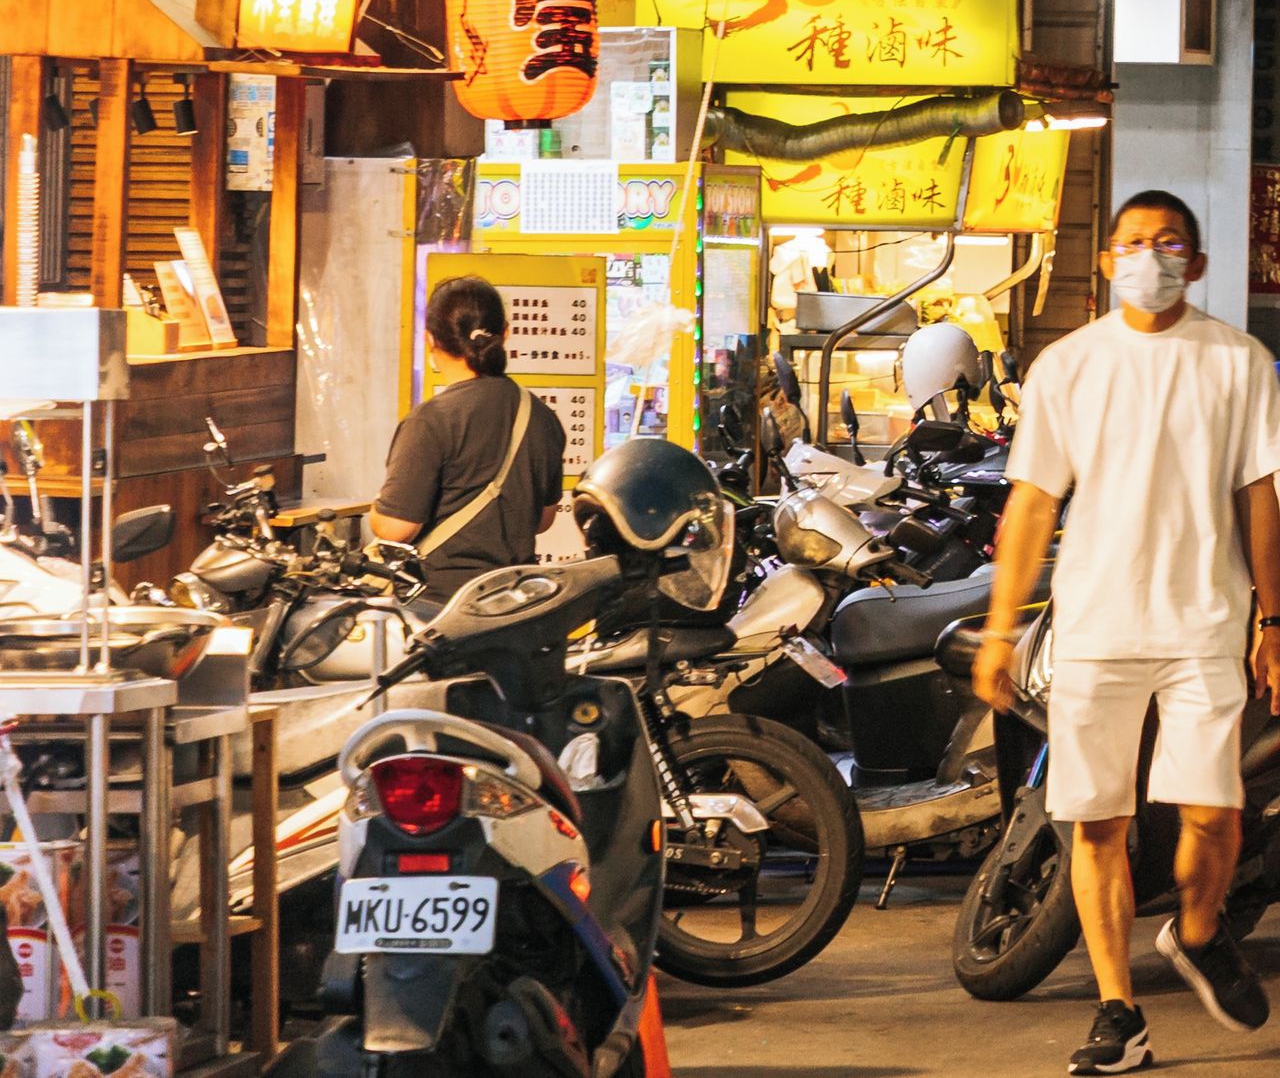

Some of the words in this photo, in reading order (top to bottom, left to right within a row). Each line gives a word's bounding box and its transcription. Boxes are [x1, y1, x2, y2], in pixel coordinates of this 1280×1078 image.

[787, 13, 964, 72] 種滷味
[822, 176, 947, 217] 種滷味
[342, 896, 491, 936] MKU-6599
